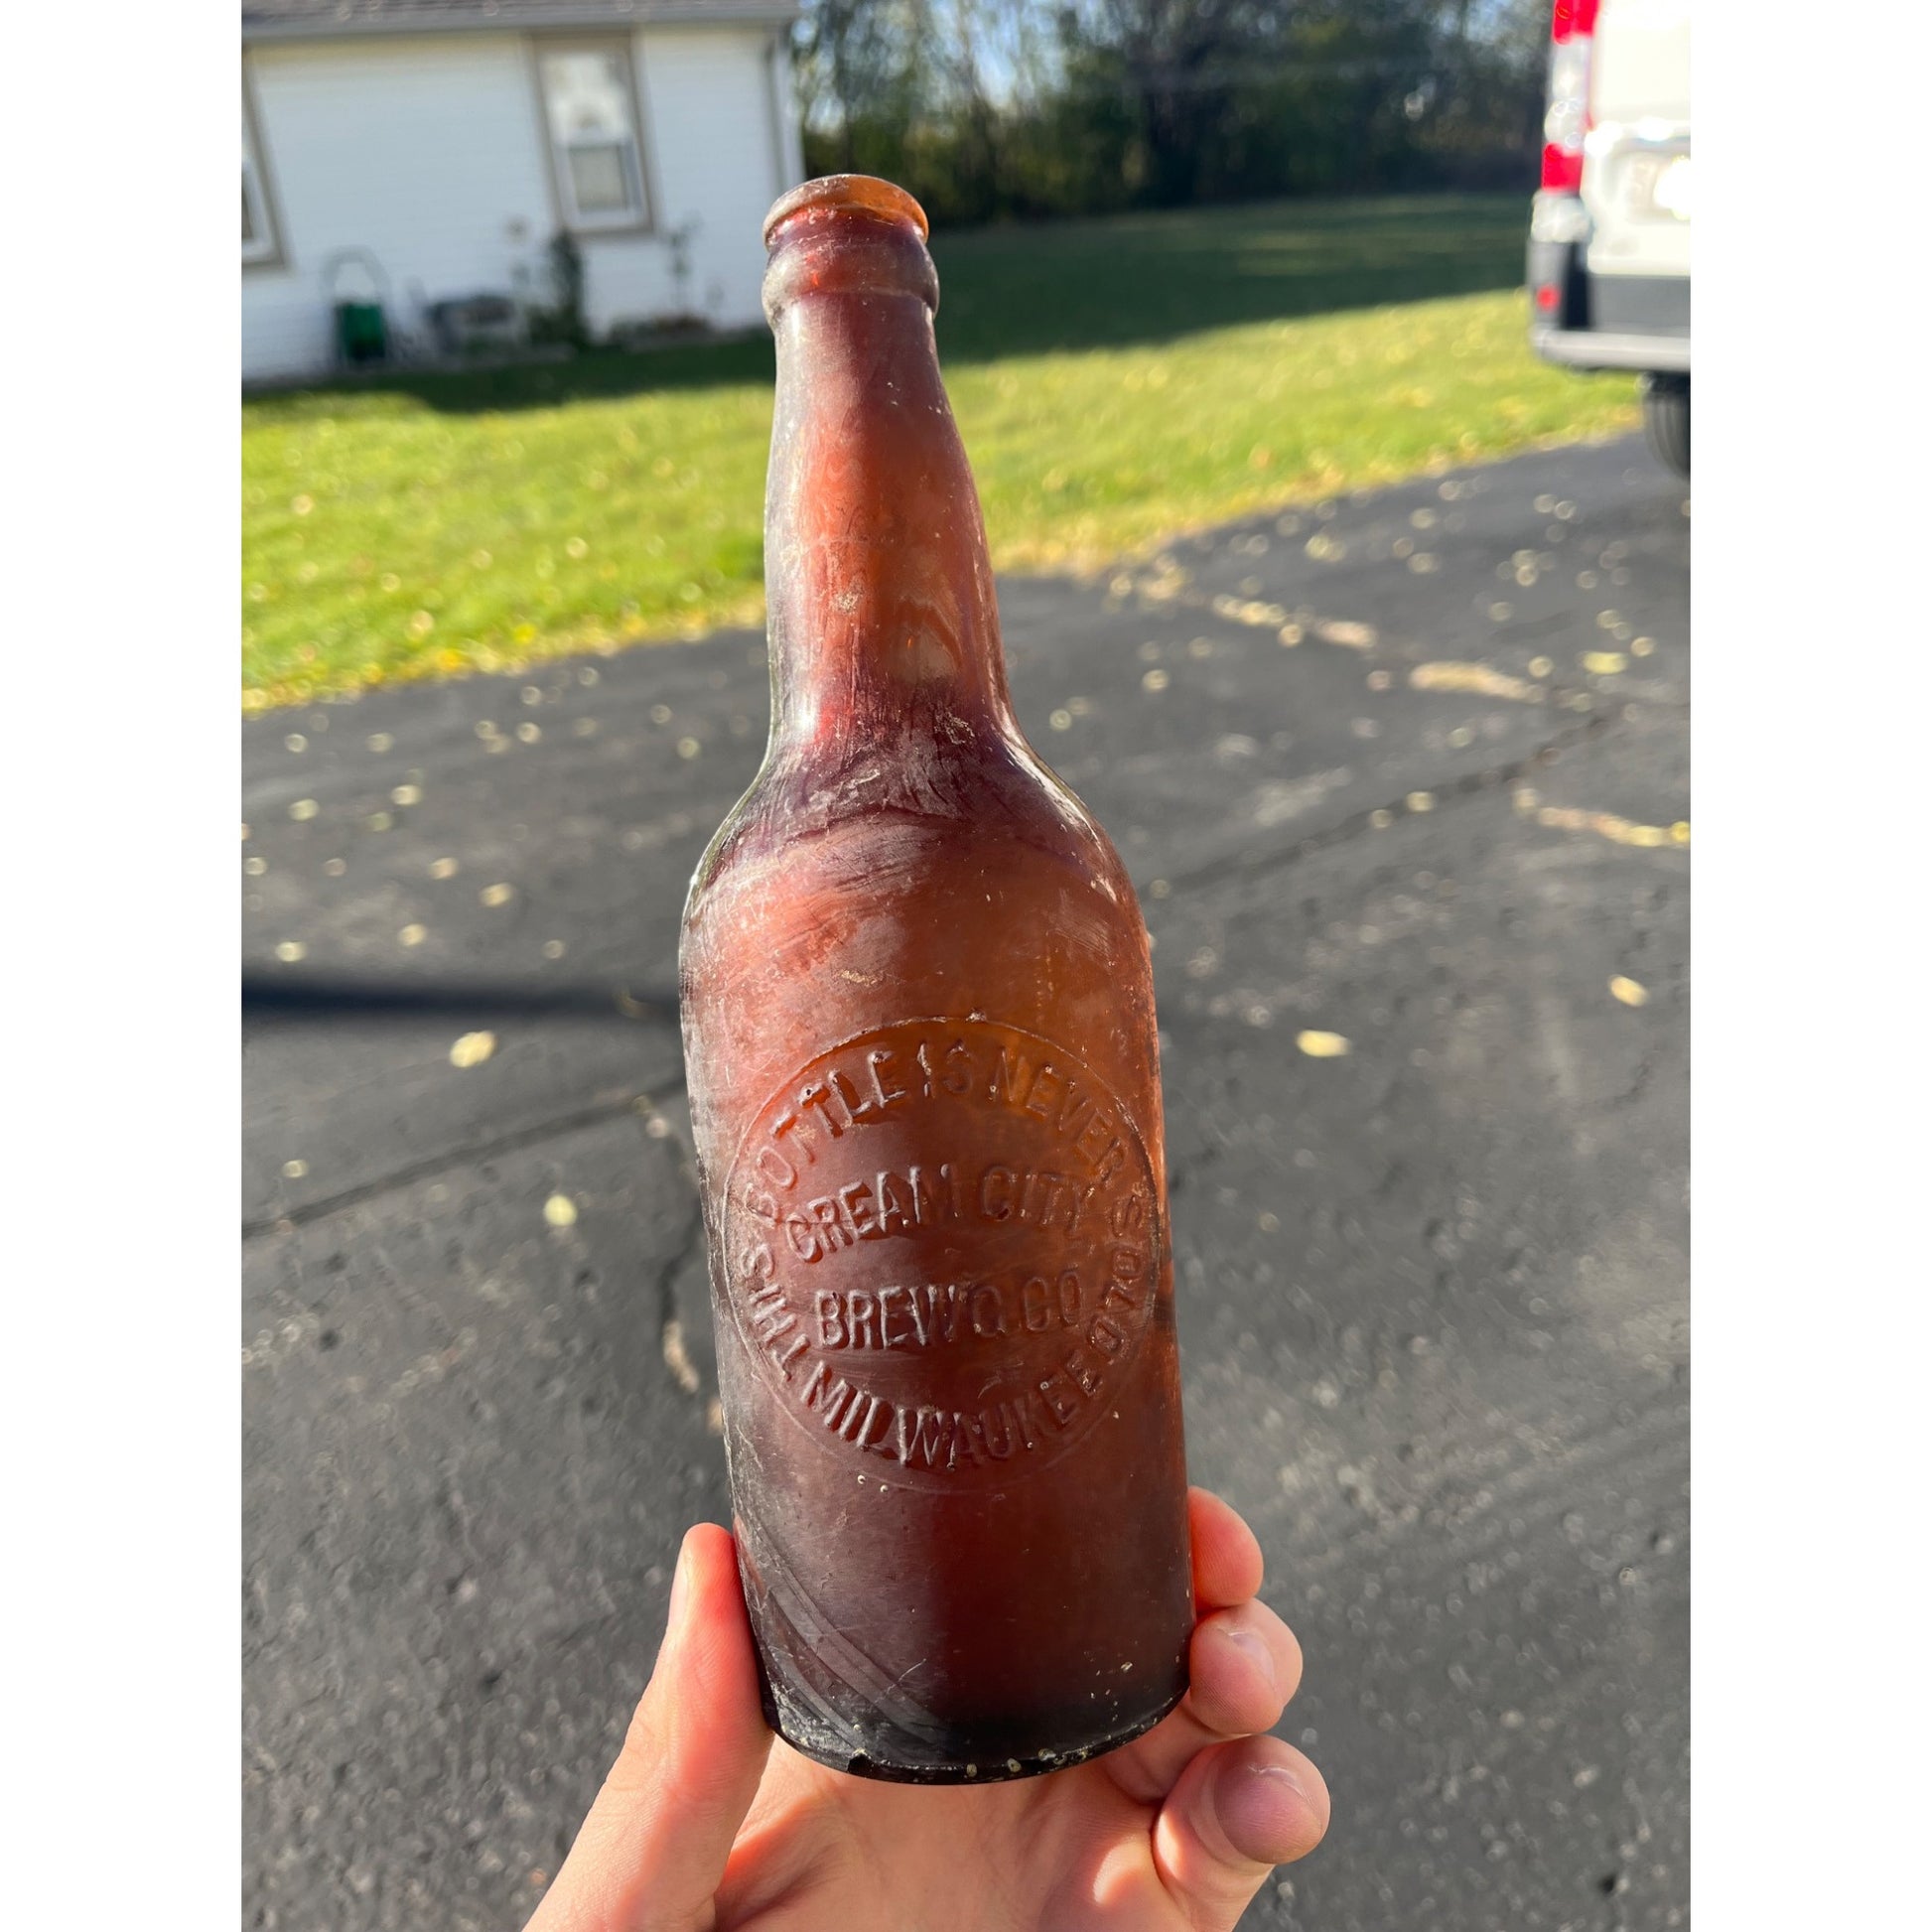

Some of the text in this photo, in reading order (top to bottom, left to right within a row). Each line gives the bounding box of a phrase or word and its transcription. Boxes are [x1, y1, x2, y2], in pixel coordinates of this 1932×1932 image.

[740, 1038, 1144, 1382] THIS BOTTLE IS NEVER SOLD
[785, 1164, 1096, 1264] CREAM CITY
[800, 1349, 1105, 1469] MILWAUKEE
